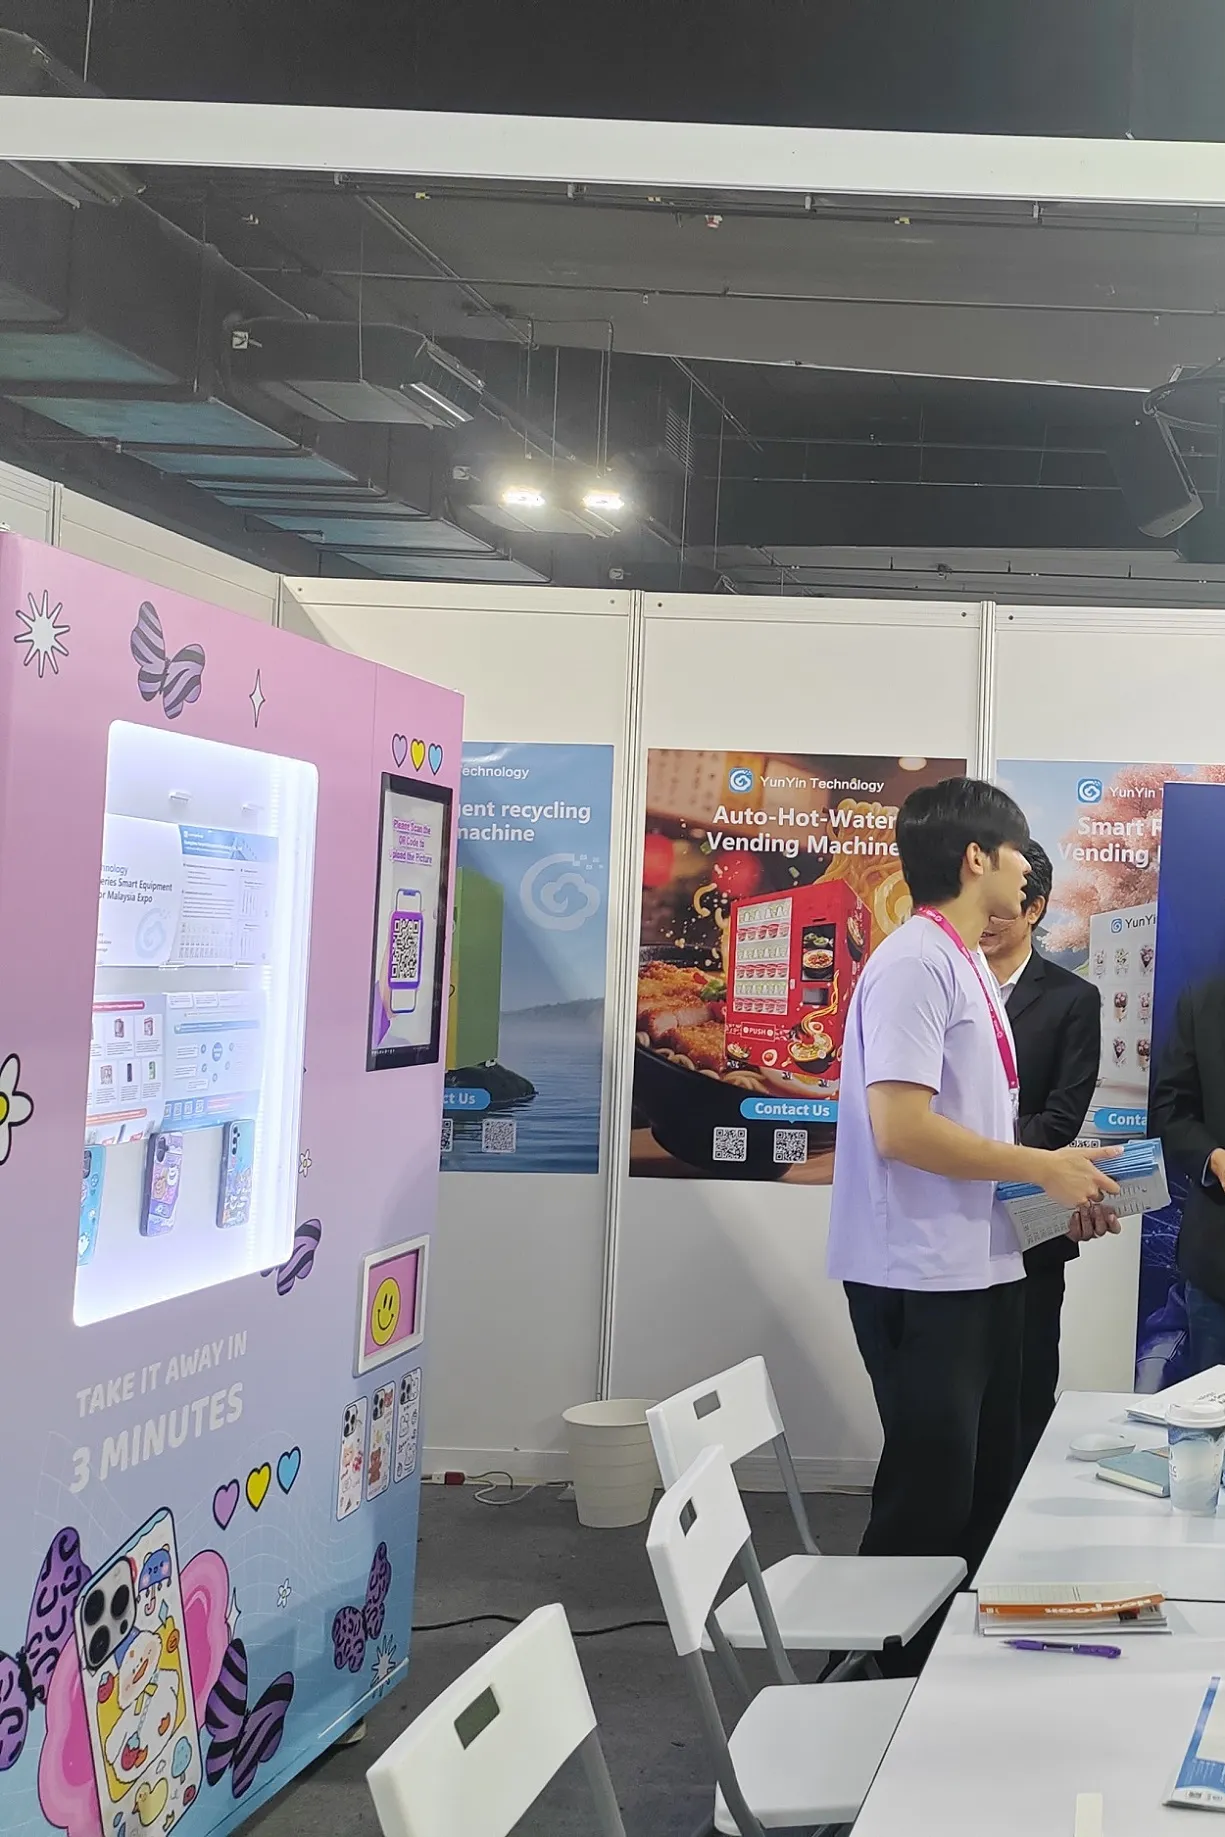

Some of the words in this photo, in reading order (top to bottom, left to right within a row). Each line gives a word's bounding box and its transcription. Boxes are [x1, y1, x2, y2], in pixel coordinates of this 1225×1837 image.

[461, 766, 530, 780] echnology
[760, 776, 807, 789] YunYin
[810, 777, 885, 793] Technology
[1109, 786, 1156, 799] YunYin
[501, 801, 592, 824] recycling
[712, 804, 897, 831] Auto-Hot-Water
[1077, 816, 1145, 838] Smart
[706, 830, 800, 859] Vending
[807, 834, 900, 857] Machine
[1057, 842, 1150, 868] Vending
[100, 877, 117, 887] eries
[118, 877, 138, 889] Smart
[139, 881, 173, 893] Equipment
[107, 890, 136, 903] Malaysia
[137, 891, 153, 904] Expo
[750, 1027, 766, 1035] PUSH
[458, 1093, 476, 1104] Us
[754, 1102, 810, 1117] Contact
[812, 1104, 830, 1117] Us
[1108, 1113, 1147, 1126] Conta
[76, 1371, 136, 1418] TAKE
[140, 1362, 162, 1395] IT
[165, 1338, 225, 1385] AWAY
[228, 1330, 248, 1361] IN
[69, 1446, 92, 1495] 3
[99, 1381, 244, 1482] MINUTES
